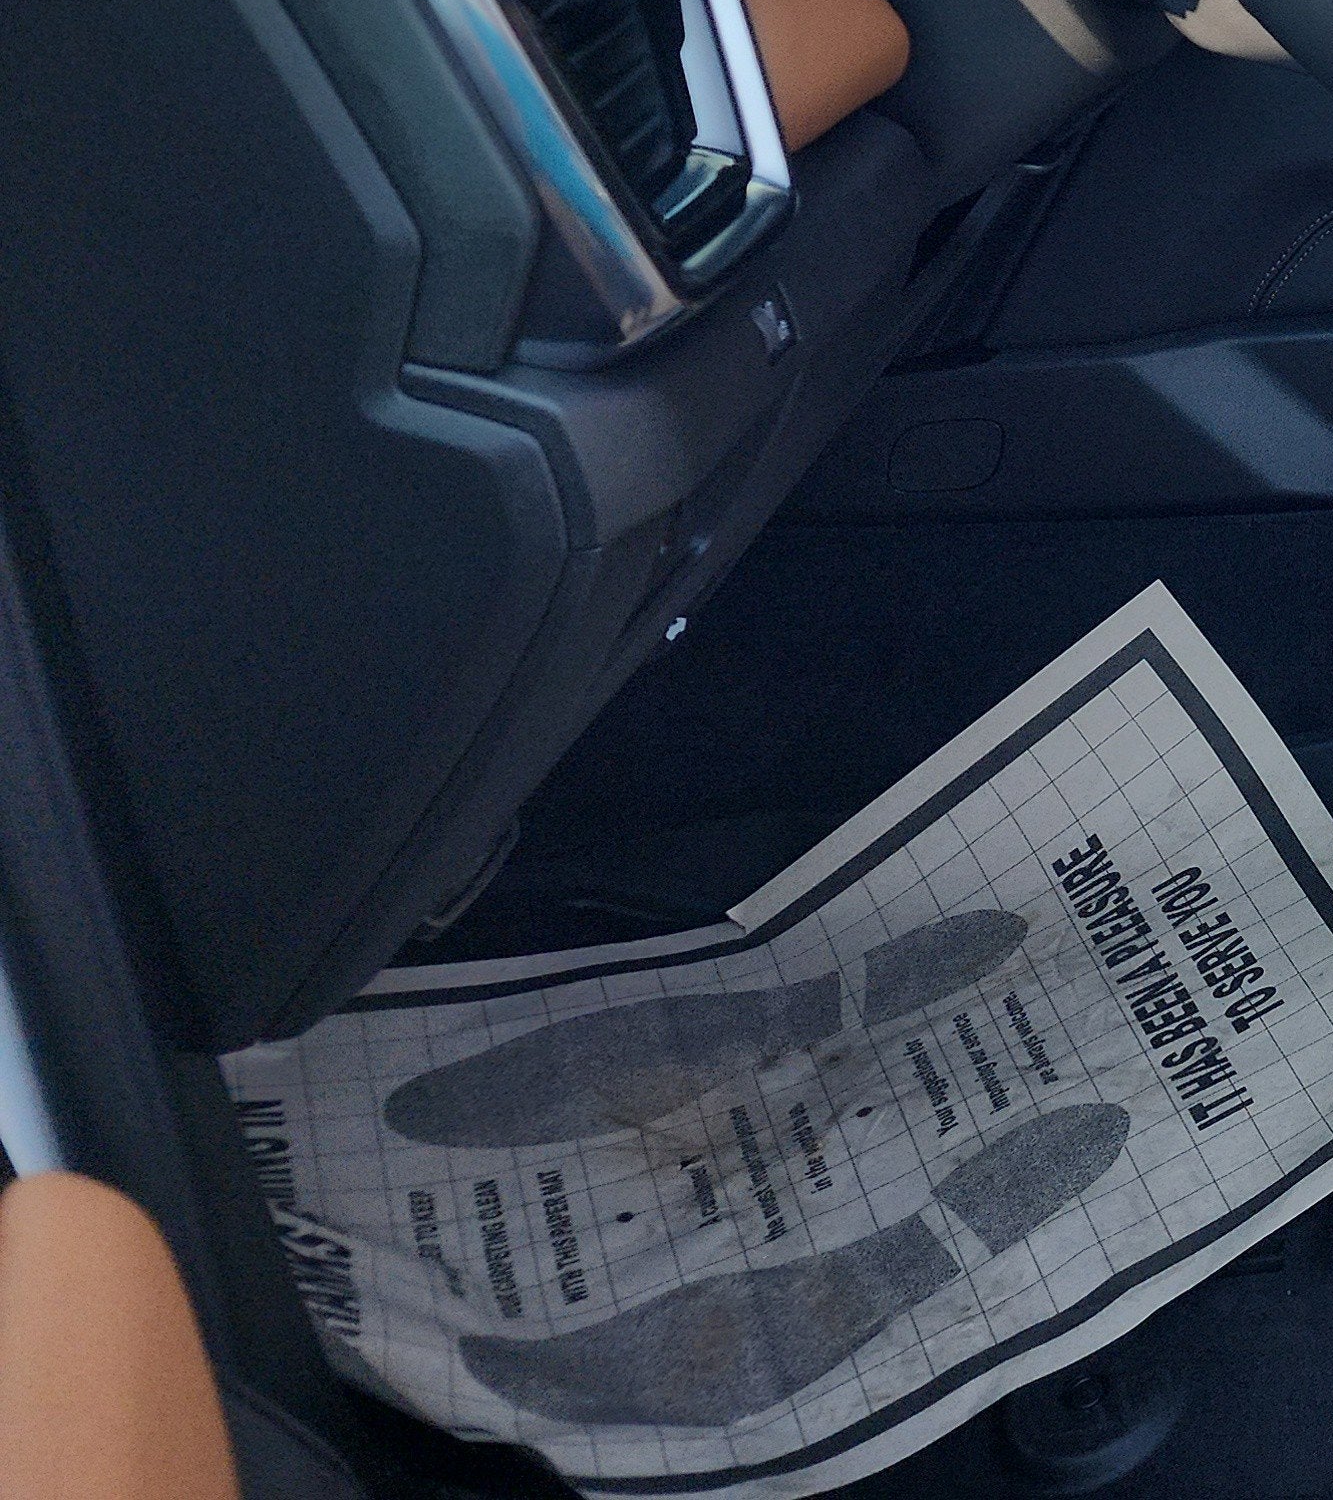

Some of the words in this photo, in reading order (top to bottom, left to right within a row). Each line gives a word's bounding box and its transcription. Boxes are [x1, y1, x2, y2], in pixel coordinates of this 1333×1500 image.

[1052, 833, 1160, 969] PLEASURE
[1151, 866, 1219, 929] YOU
[1116, 950, 1172, 985] A
[1178, 911, 1264, 999] SERVE
[951, 1011, 981, 1050] service
[1001, 989, 1033, 1039] welcome.
[1125, 972, 1208, 1049] BEEN
[1225, 986, 1285, 1034] TO
[903, 1037, 924, 1057] for
[1020, 1034, 1050, 1071] always
[1161, 1036, 1238, 1100] HAS
[910, 1050, 949, 1107] suggestions
[971, 1060, 1010, 1115] improving
[932, 1104, 959, 1138] Your
[1188, 1086, 1254, 1131] IT
[535, 1168, 565, 1196] MAT
[806, 1155, 827, 1178] the
[472, 1178, 503, 1222] CLEAN
[542, 1193, 576, 1239] PAPER
[751, 1183, 780, 1219] most
[763, 1215, 787, 1240] the
[550, 1236, 580, 1270] THIS
[556, 1267, 589, 1305] WITH
